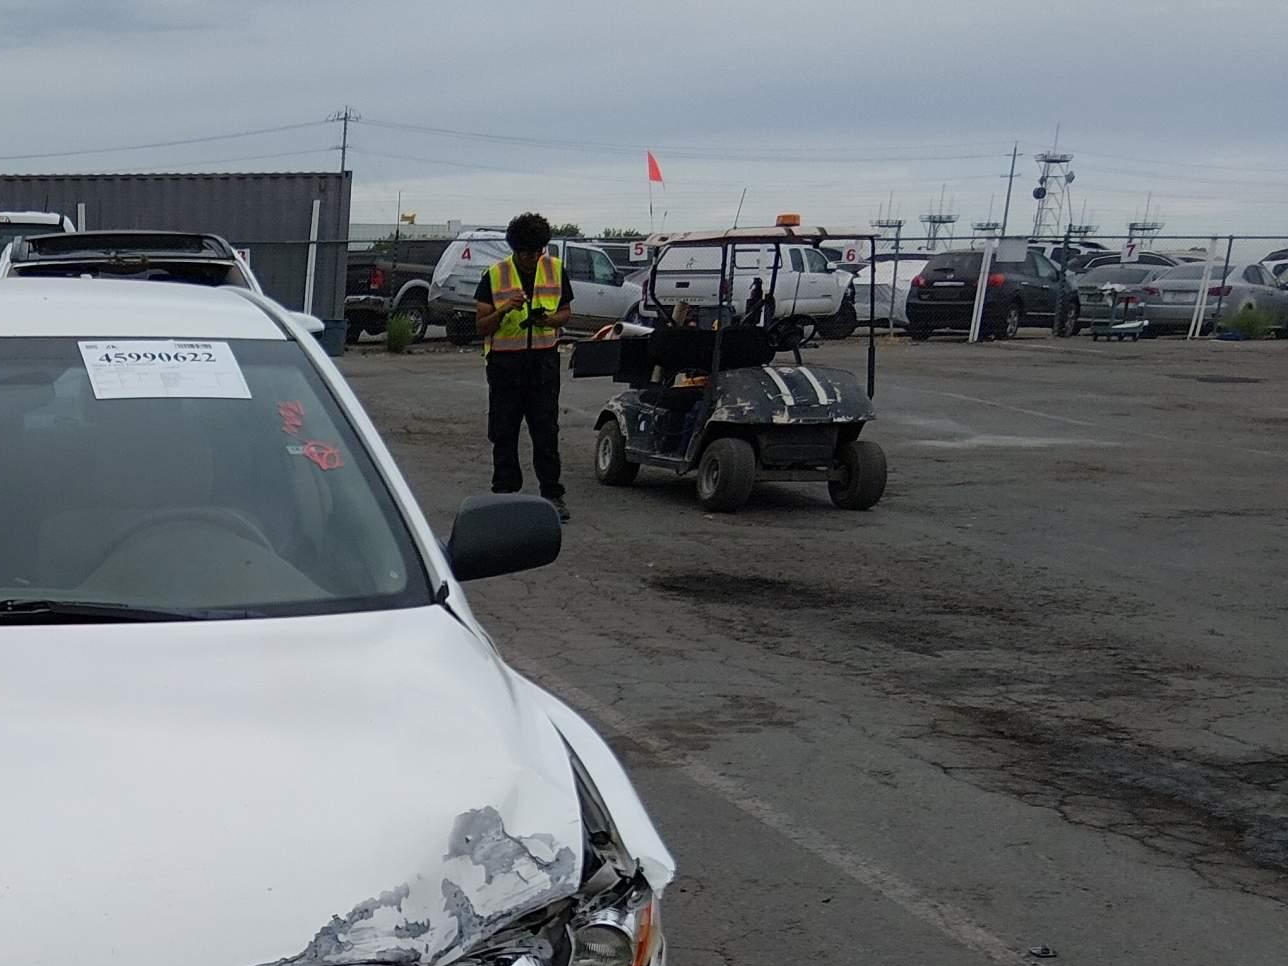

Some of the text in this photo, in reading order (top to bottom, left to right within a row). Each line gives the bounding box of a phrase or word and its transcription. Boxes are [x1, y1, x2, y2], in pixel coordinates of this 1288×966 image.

[461, 247, 472, 261] 4
[634, 242, 644, 256] 5
[846, 248, 856, 262] 6
[1126, 244, 1136, 257] 7
[98, 352, 217, 363] 45990622
